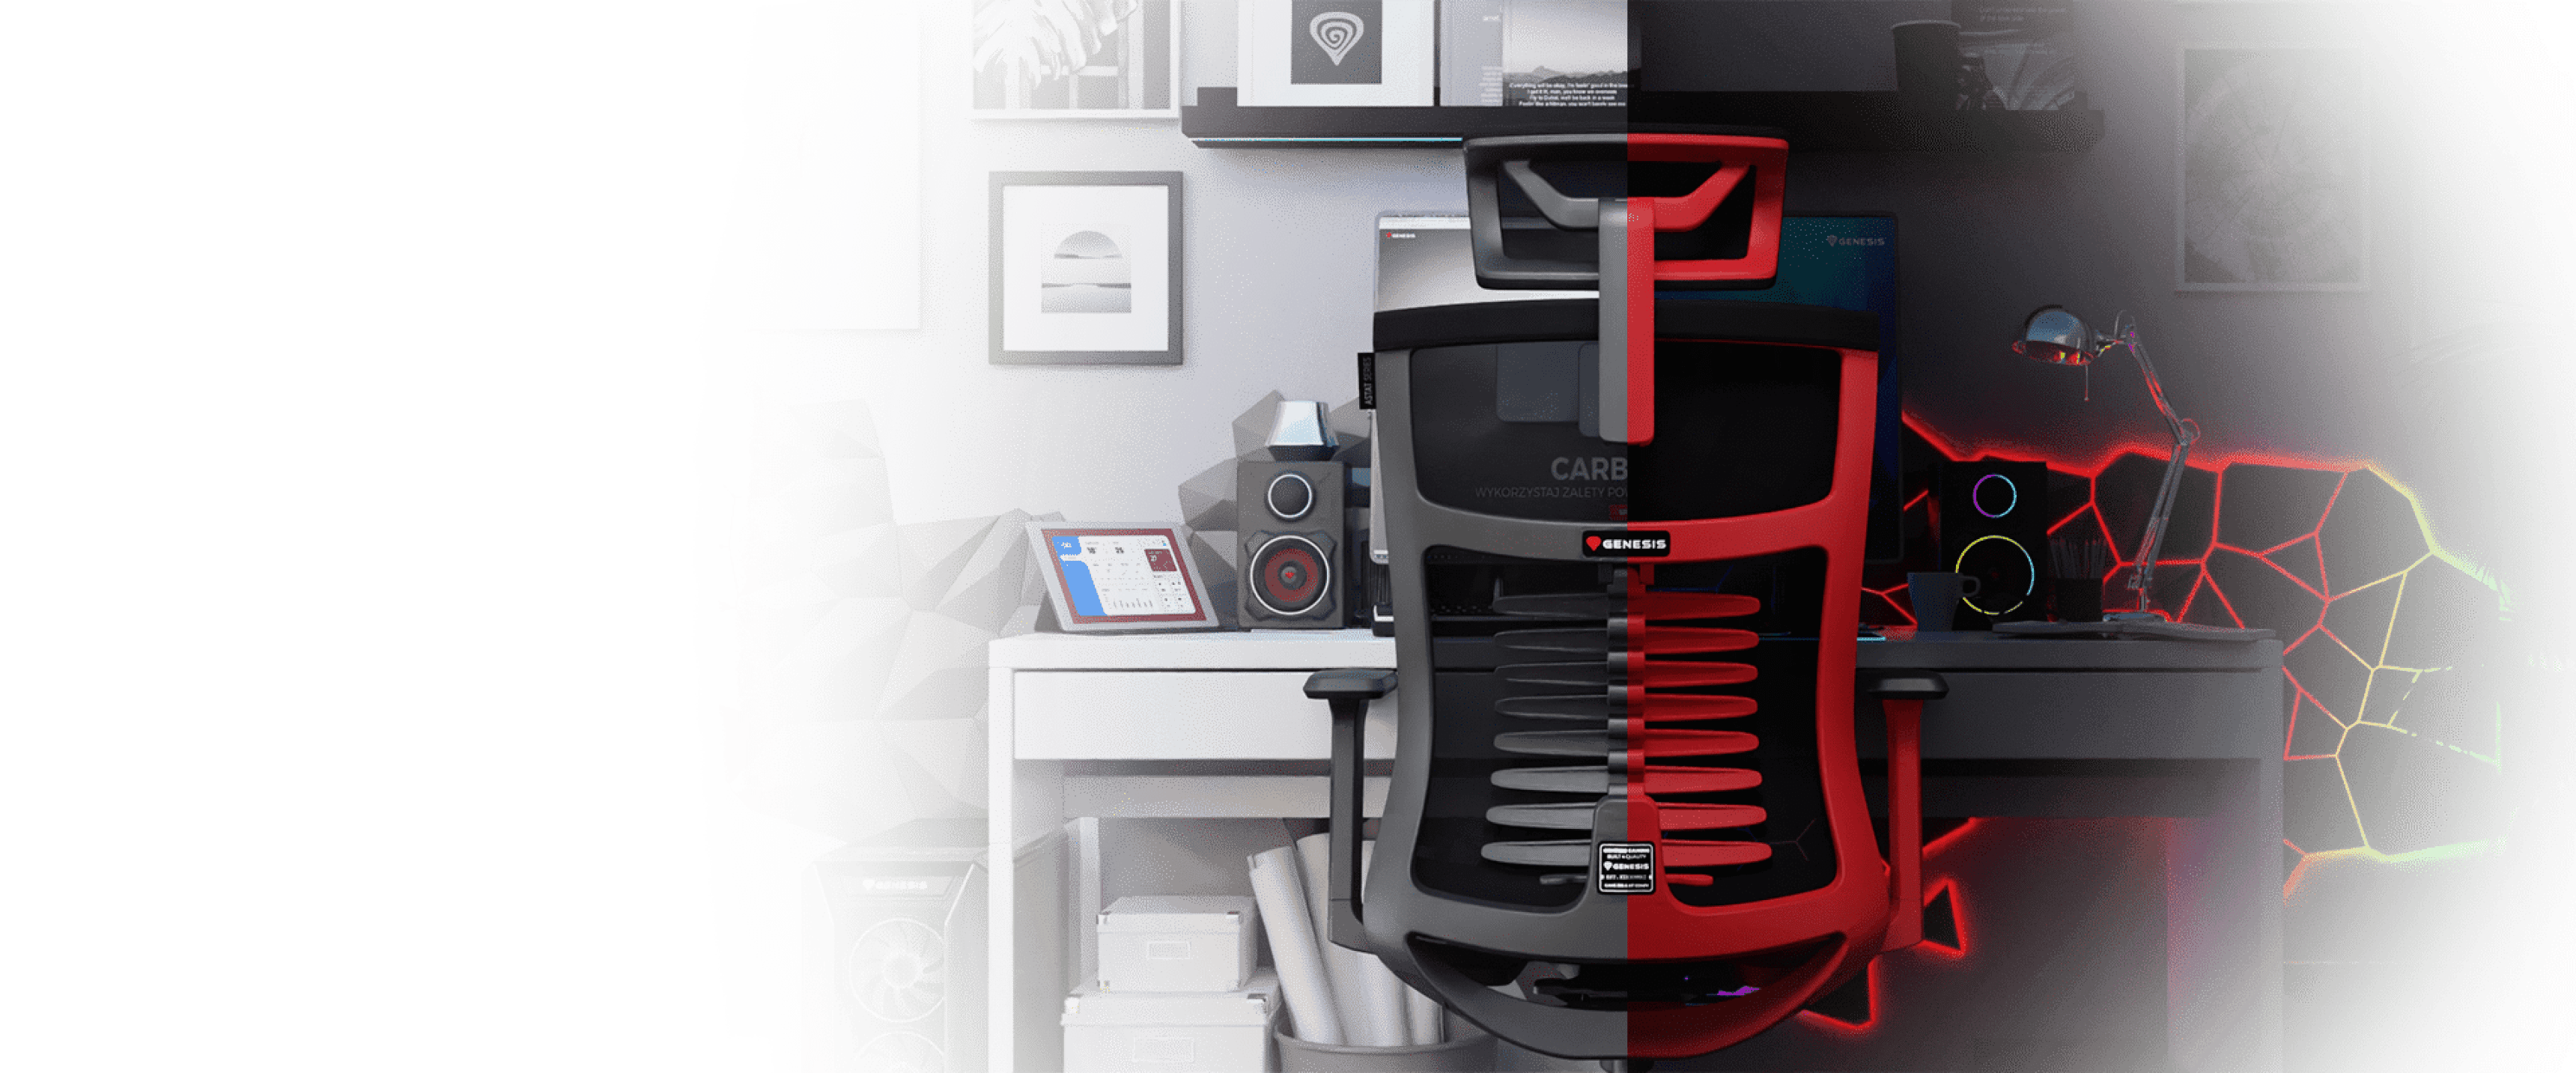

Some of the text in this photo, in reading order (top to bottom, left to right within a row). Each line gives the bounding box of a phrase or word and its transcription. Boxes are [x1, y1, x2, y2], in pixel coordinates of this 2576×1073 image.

[1838, 237, 1886, 246] GENESIS
[1364, 383, 1373, 406] ASTAT
[1475, 487, 1627, 498] WYKORZYSTAJ ZALETY PO
[1602, 538, 1667, 550] GENESIS
[875, 881, 928, 890] GENESIS
